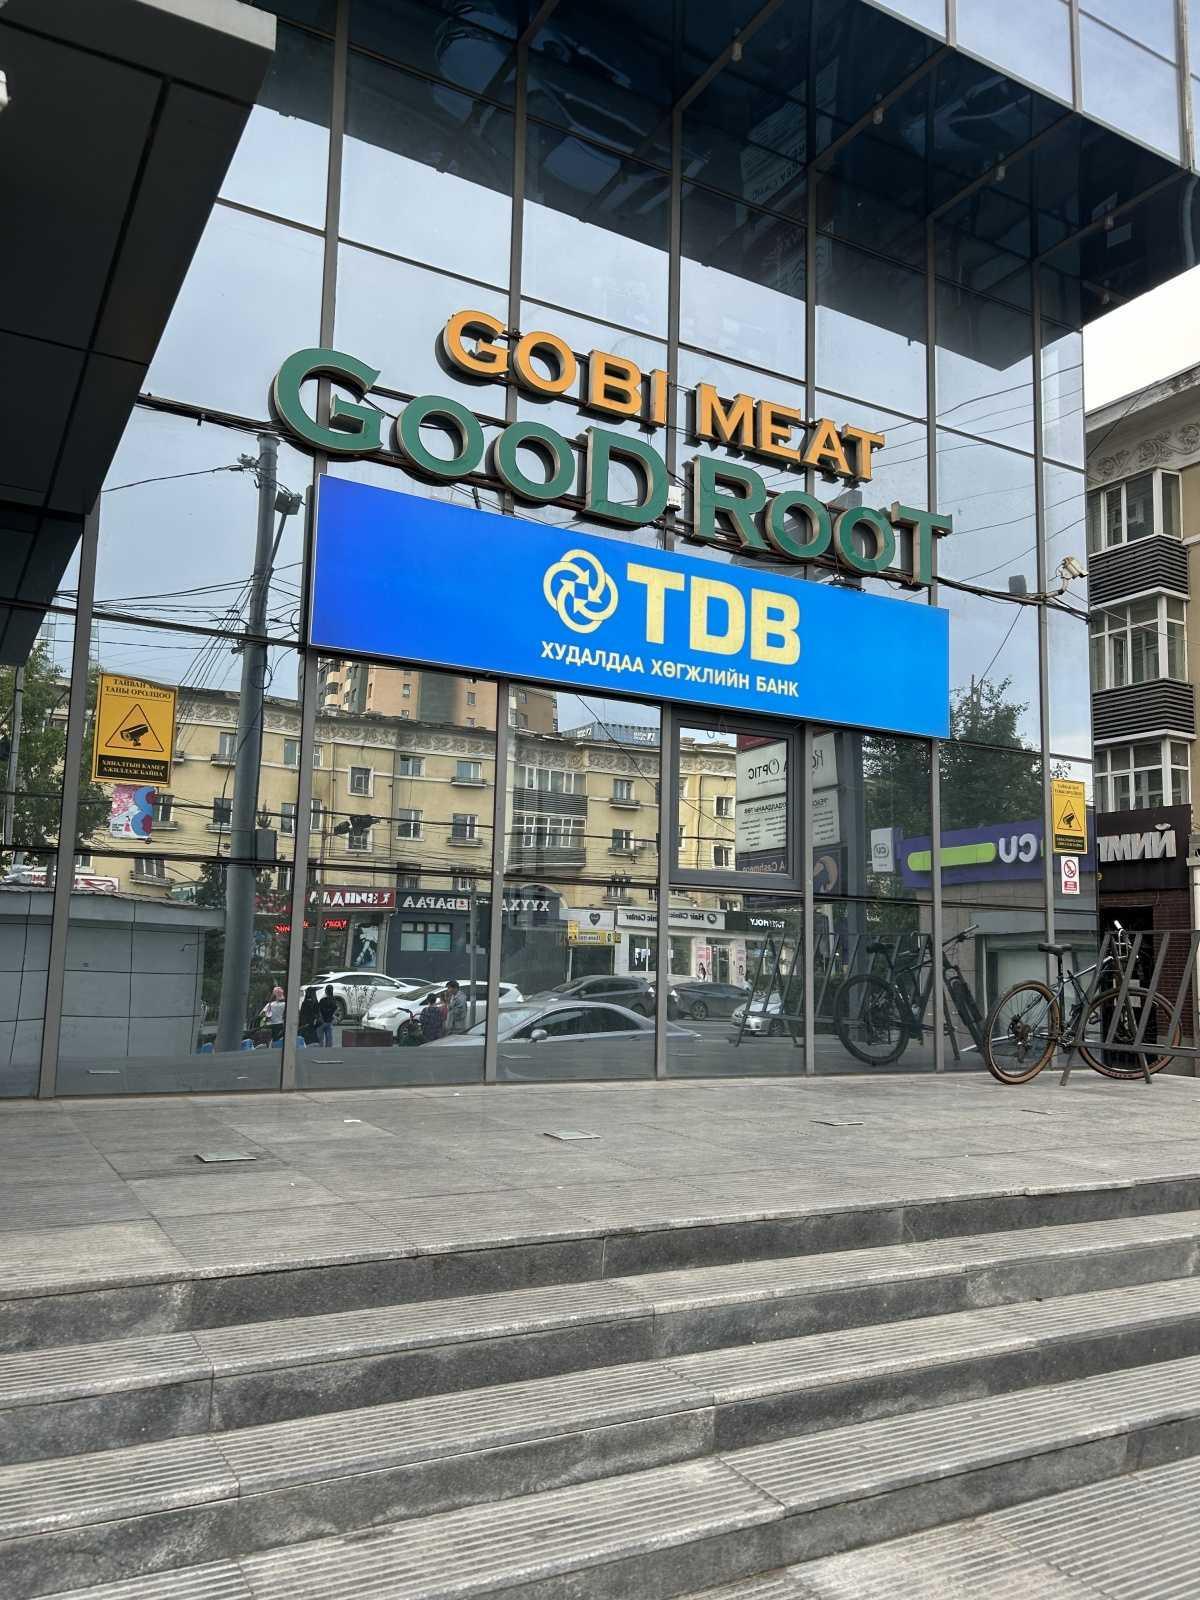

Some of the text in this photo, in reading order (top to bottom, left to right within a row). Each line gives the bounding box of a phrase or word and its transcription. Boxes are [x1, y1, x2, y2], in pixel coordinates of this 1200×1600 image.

[443, 309, 887, 483] GOBI MEAT
[273, 346, 954, 587] GOOD ROOT
[626, 562, 802, 666] TDB
[104, 685, 130, 695] ТАНЫ
[540, 640, 800, 698] ХУДАЛДАА ХӨГЖЛИЙН БАНК
